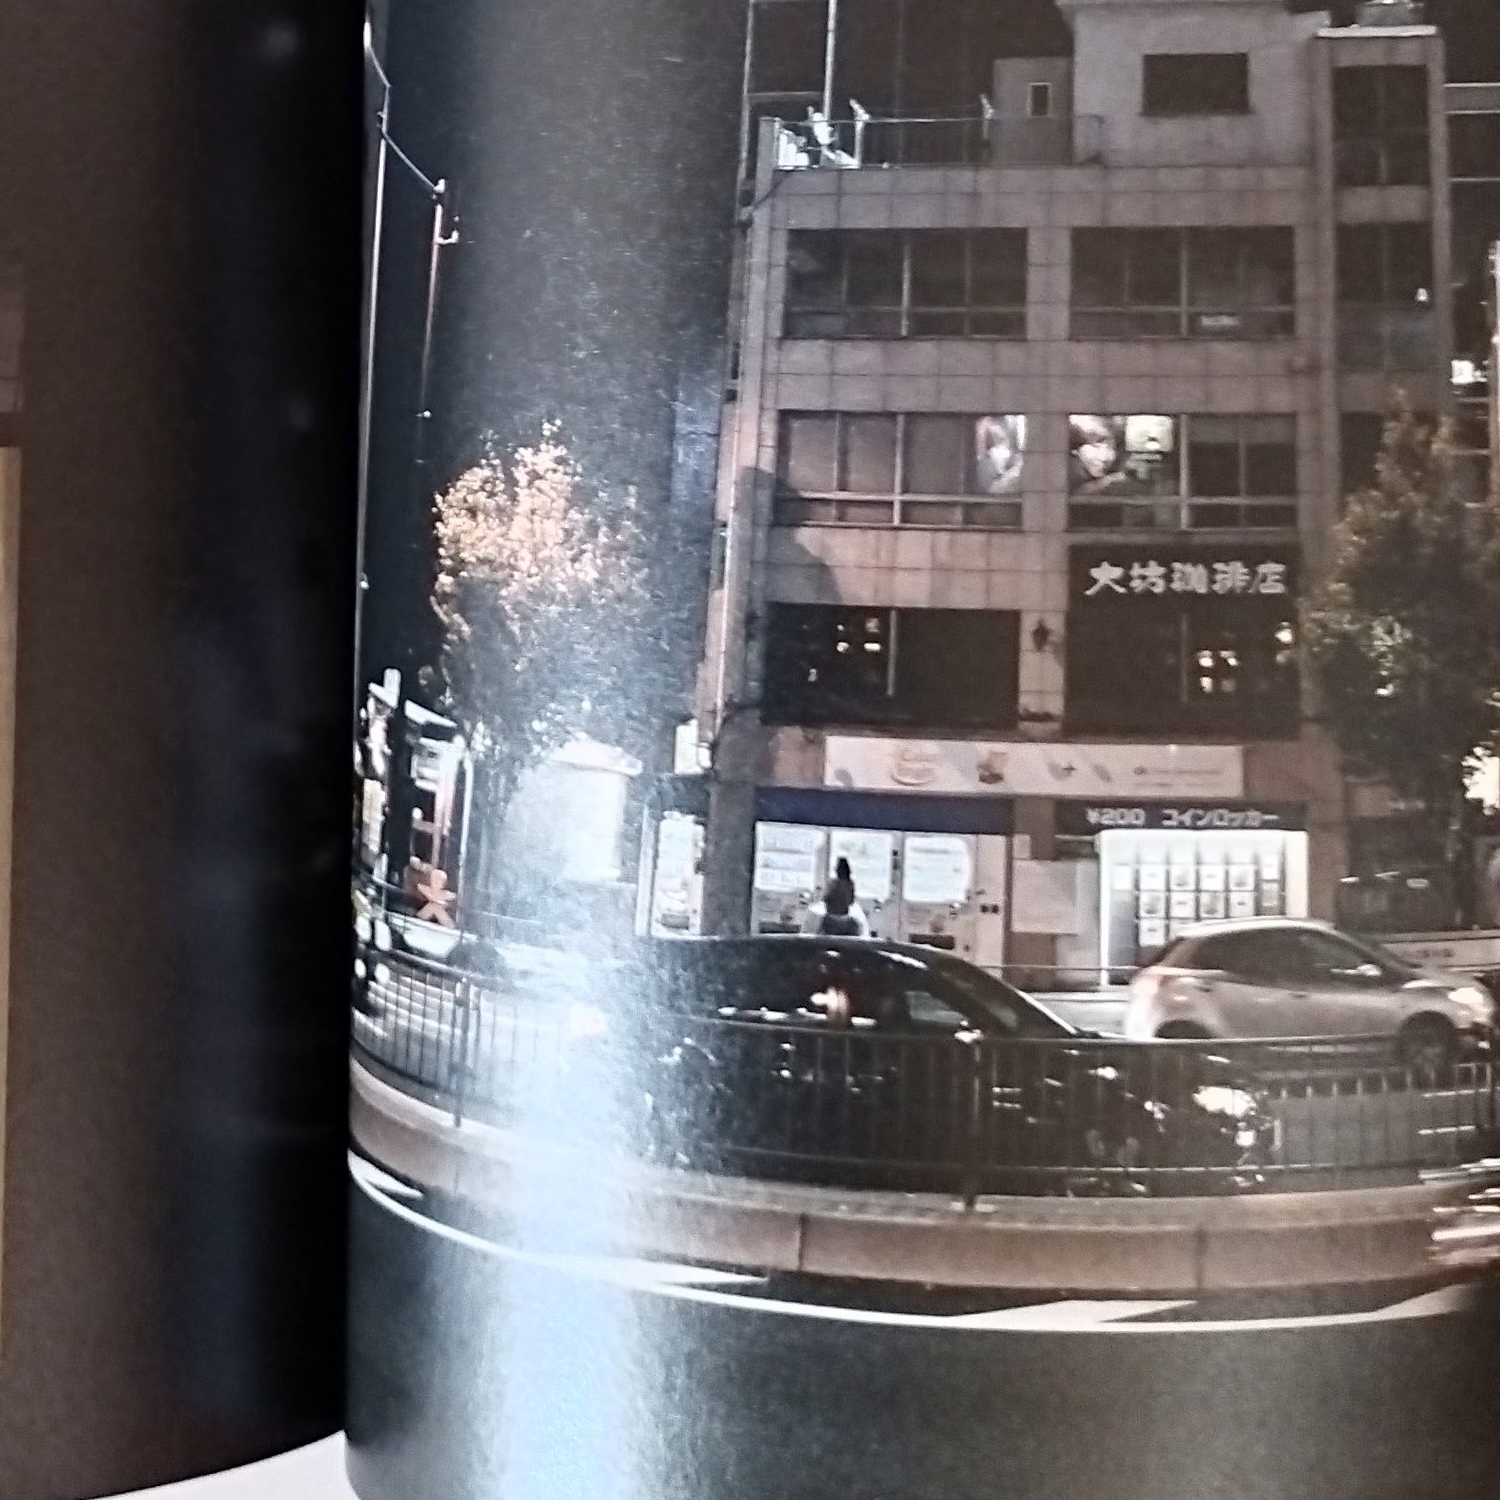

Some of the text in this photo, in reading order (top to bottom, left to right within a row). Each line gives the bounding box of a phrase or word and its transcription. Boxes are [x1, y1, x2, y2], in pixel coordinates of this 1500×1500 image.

[1084, 560, 1287, 596] 大坊珈琲店
